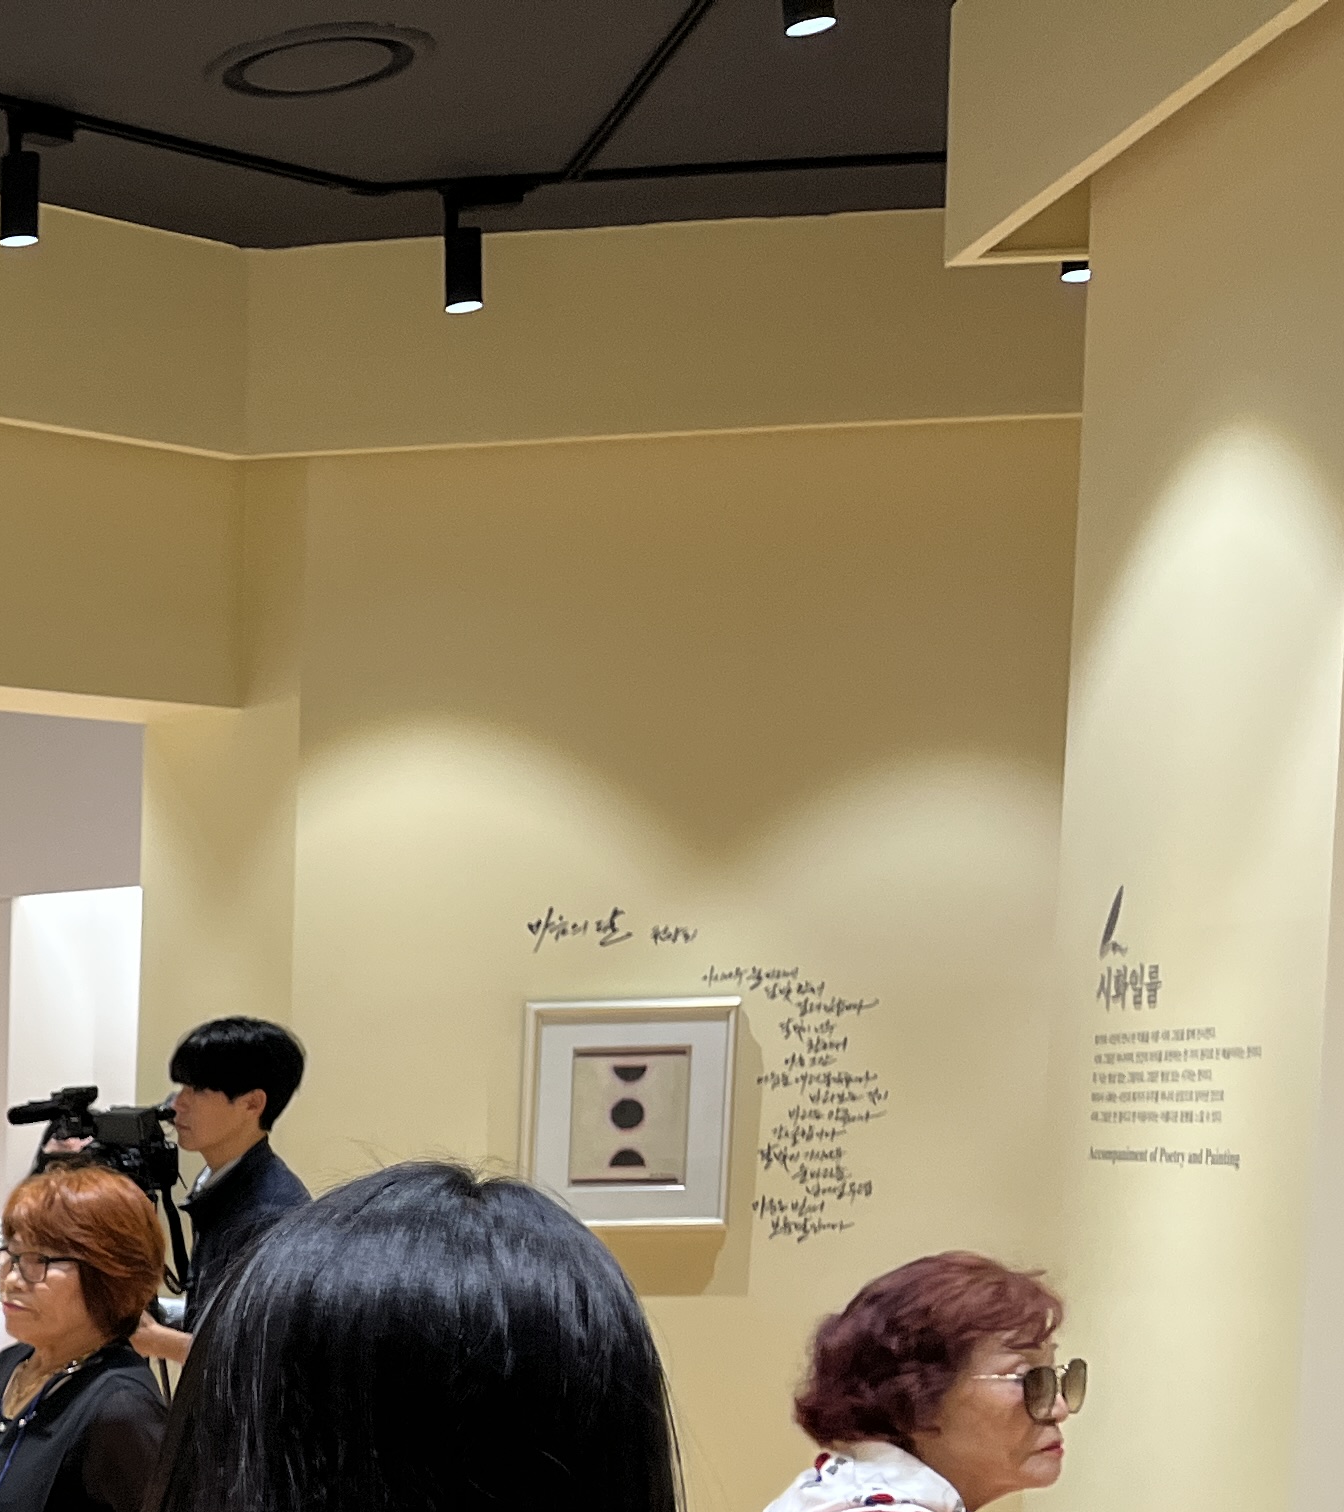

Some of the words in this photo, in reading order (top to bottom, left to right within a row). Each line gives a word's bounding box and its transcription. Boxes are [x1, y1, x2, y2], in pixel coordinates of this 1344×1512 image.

[1150, 1146, 1159, 1162] of
[1159, 1146, 1185, 1168] Poetry
[1188, 1148, 1203, 1165] and
[1206, 1147, 1241, 1171] Painting
